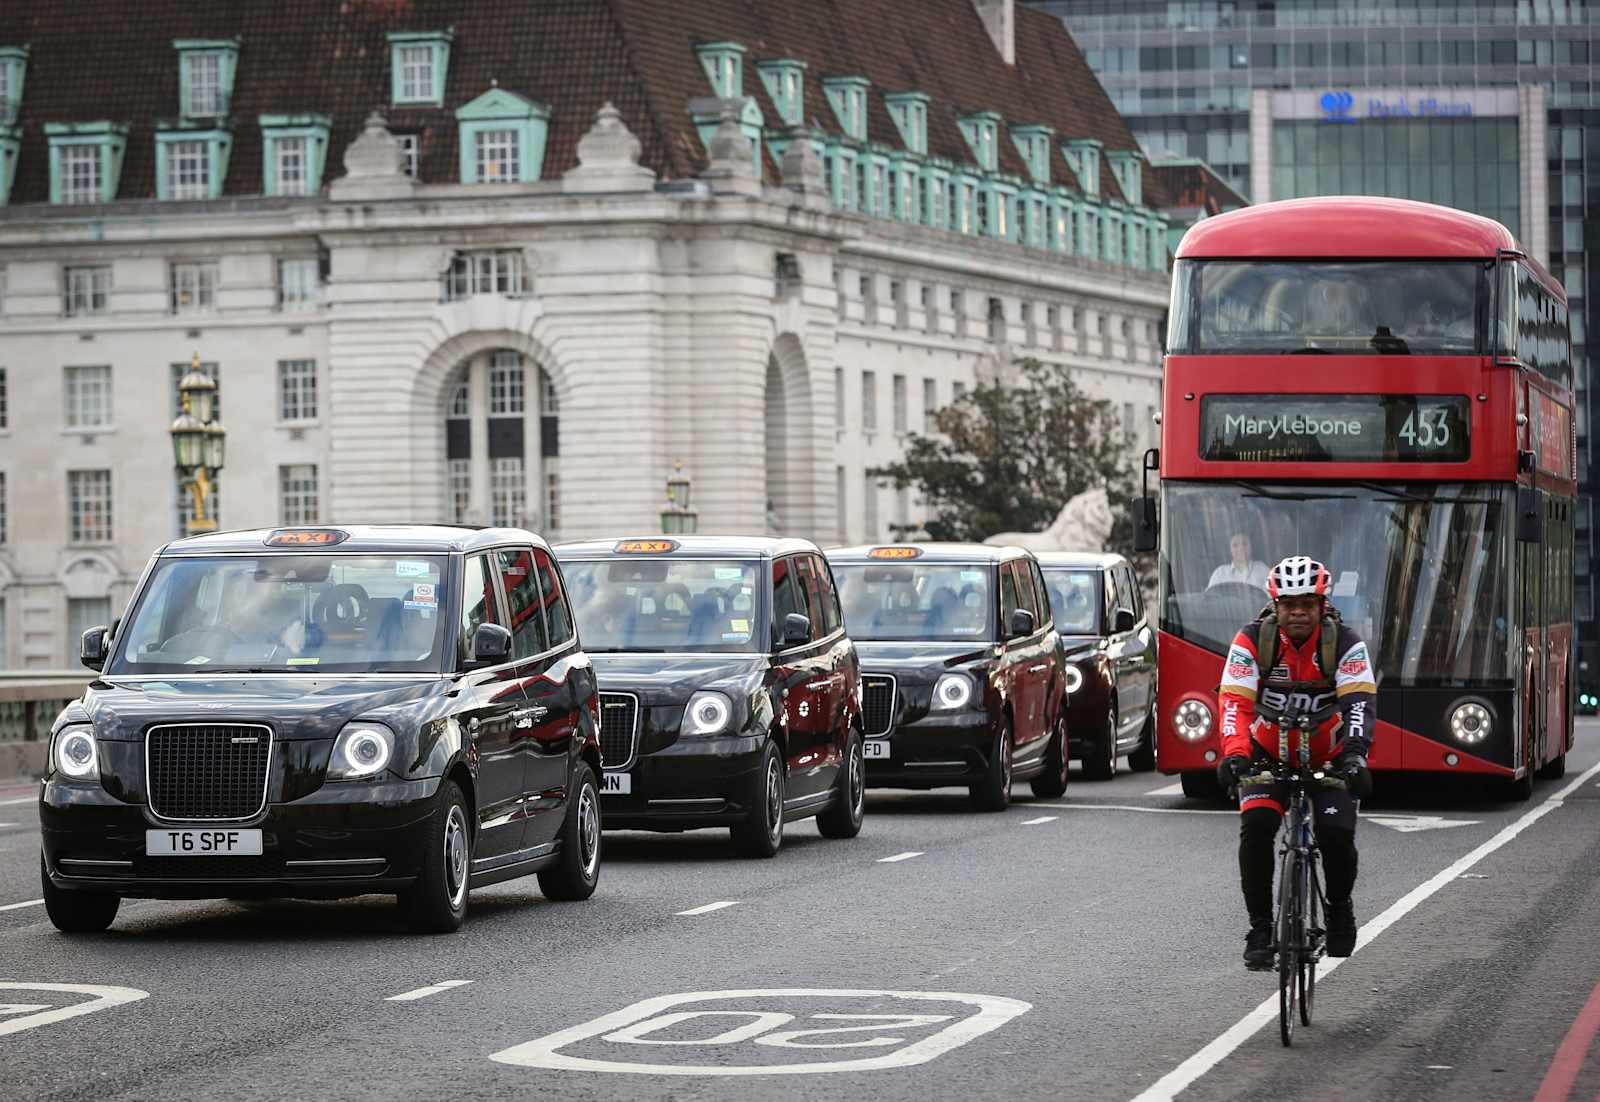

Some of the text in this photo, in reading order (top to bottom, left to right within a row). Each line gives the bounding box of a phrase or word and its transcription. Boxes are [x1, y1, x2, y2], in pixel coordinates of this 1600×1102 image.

[1224, 414, 1363, 440] Marylebone
[1398, 408, 1450, 447] 453
[621, 542, 667, 552] TAXI
[1261, 686, 1336, 713] BMC
[1222, 699, 1239, 737] BMC
[864, 743, 881, 756] FD
[168, 832, 240, 851] T6 SPF
[601, 1010, 954, 1048] 20
